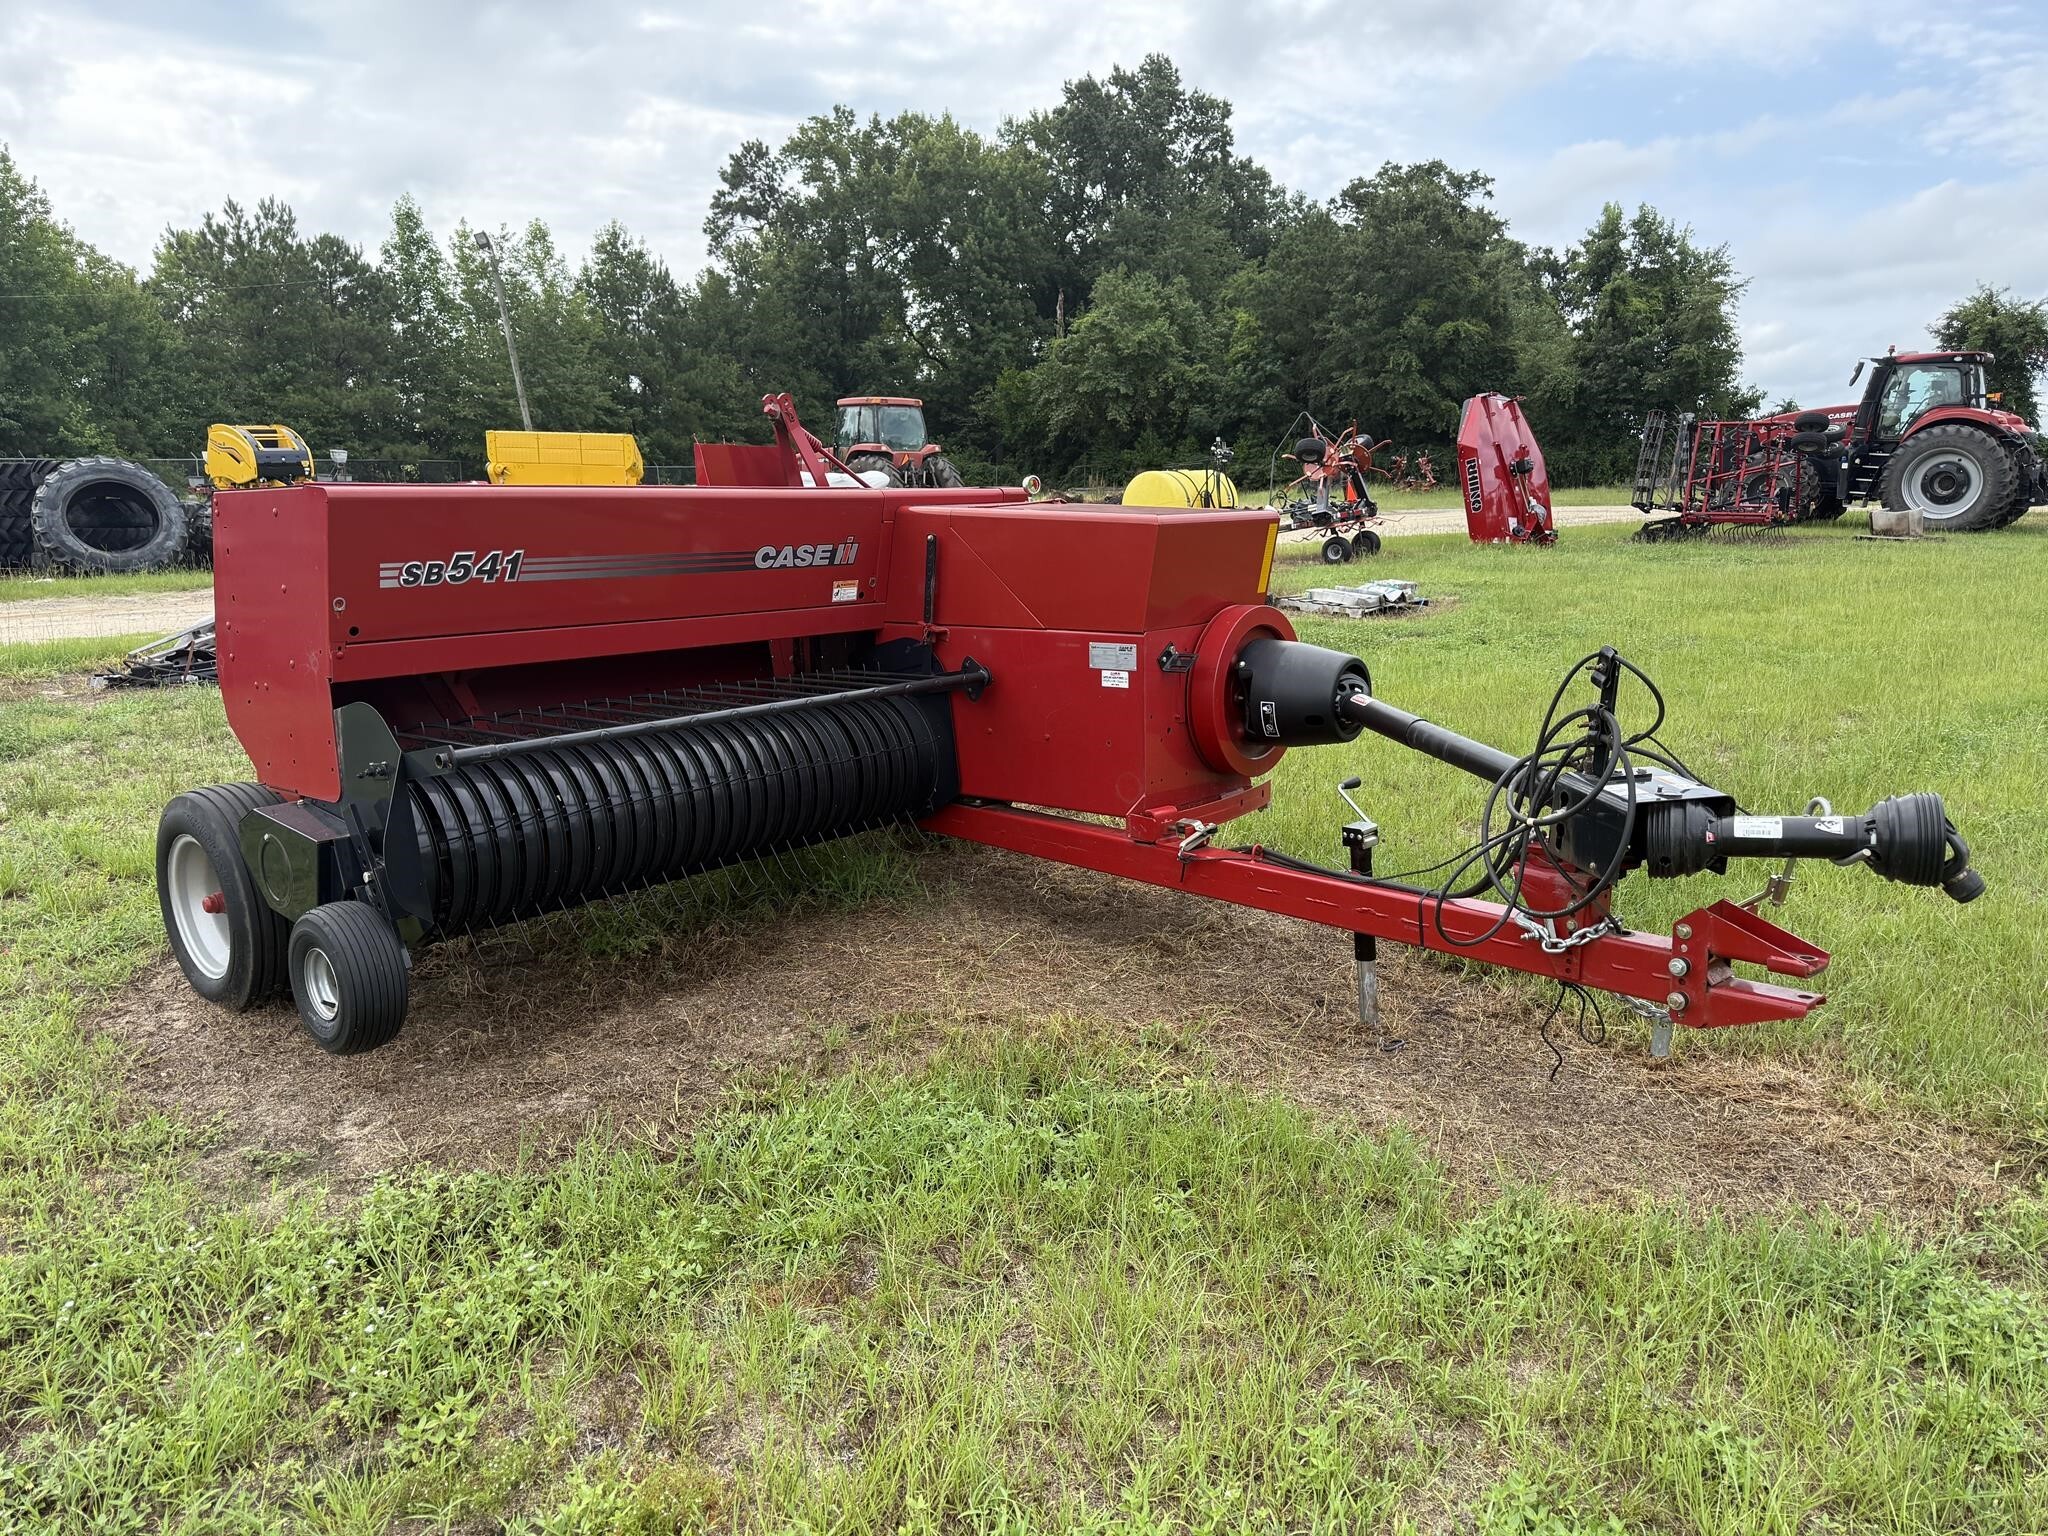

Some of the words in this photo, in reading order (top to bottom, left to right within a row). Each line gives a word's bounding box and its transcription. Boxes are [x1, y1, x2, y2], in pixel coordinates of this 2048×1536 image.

[1465, 457, 1482, 512] RHINO
[400, 550, 524, 587] SB541
[754, 544, 833, 569] CASE
